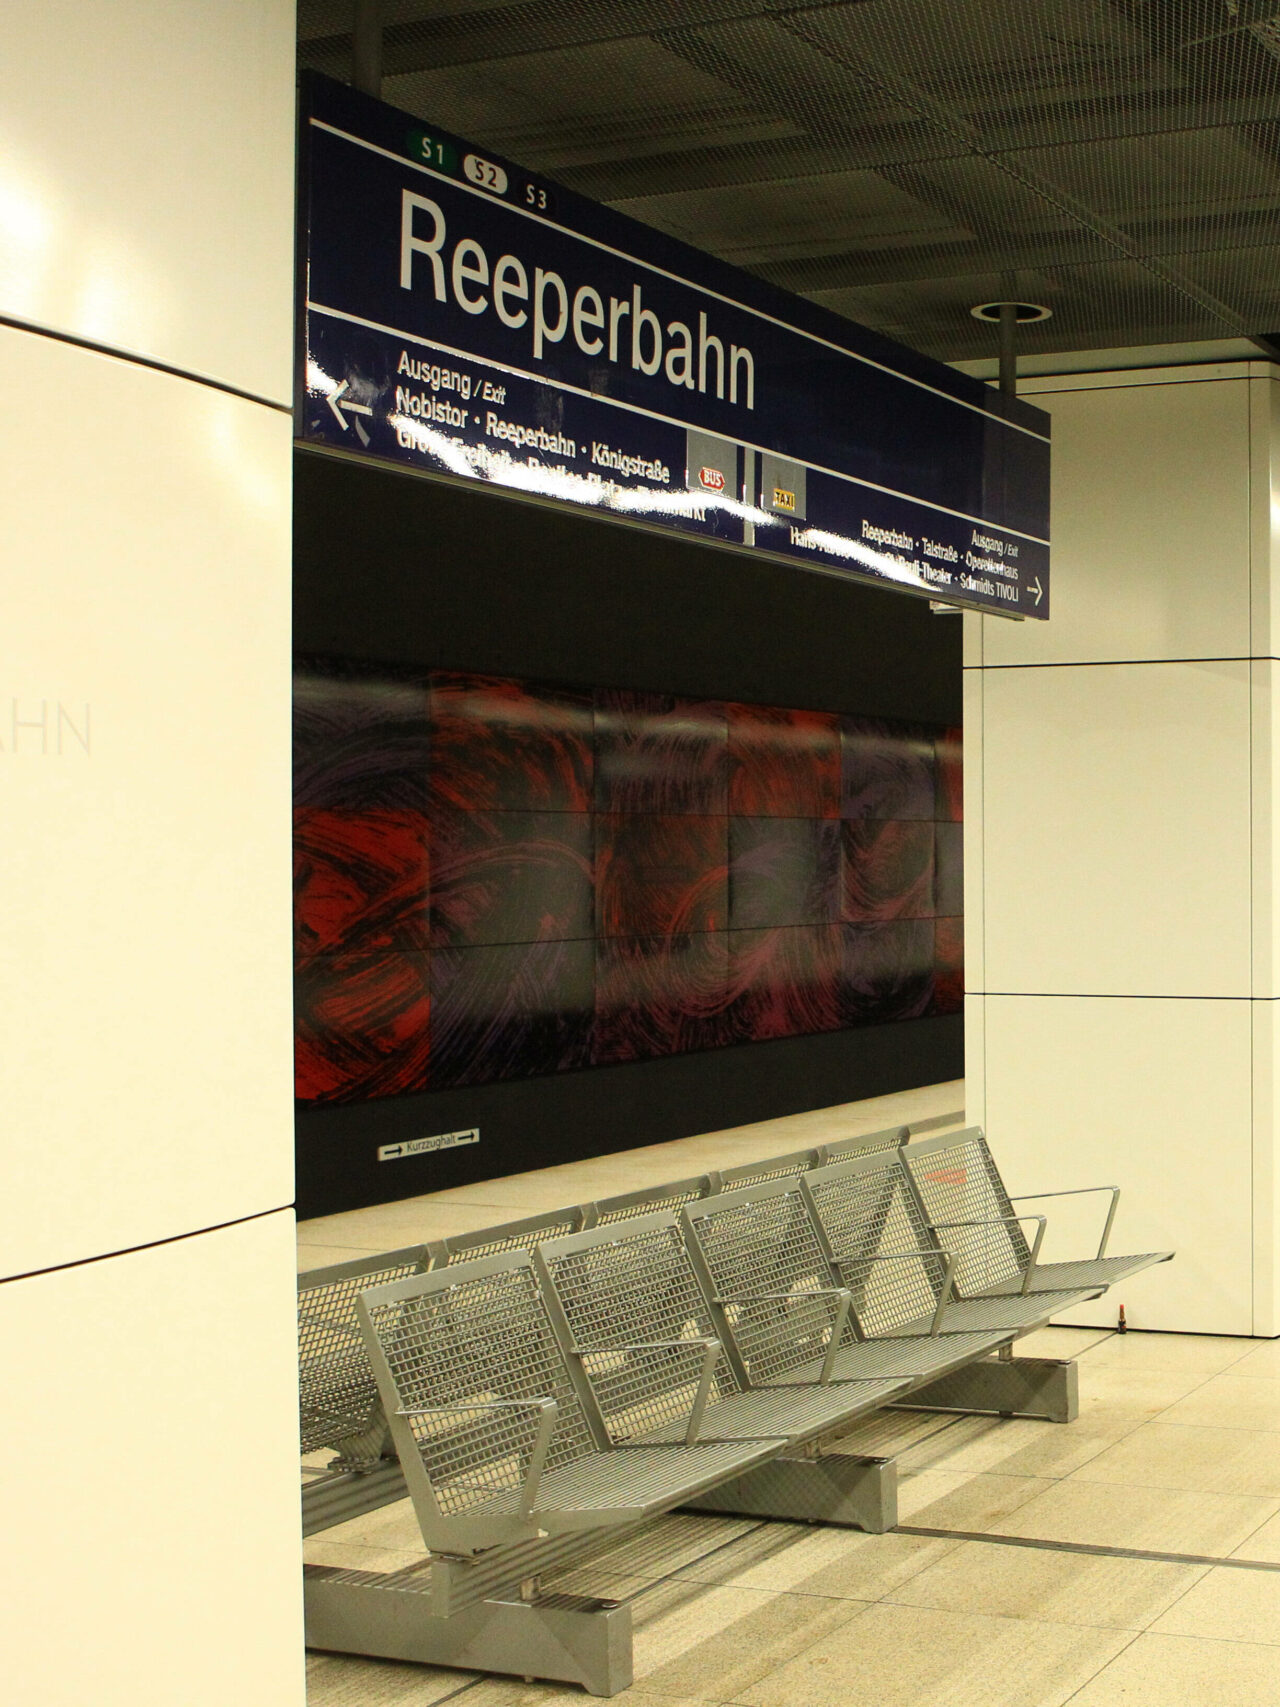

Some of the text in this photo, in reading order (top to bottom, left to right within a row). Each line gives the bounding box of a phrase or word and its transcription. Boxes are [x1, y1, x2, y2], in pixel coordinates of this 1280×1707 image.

[421, 136, 548, 210] S1 S2 S3
[399, 186, 755, 411] Reeperbahn
[396, 350, 471, 400] Ausgang
[482, 380, 506, 405] Exit
[395, 385, 469, 429] Nobistor
[485, 410, 577, 459] Reeperbahn
[591, 441, 671, 484] Königstraße
[702, 471, 723, 487] BUS
[775, 490, 795, 508] TAXI
[861, 519, 914, 551] Reeperbahn
[922, 536, 959, 564] Talstraße
[965, 550, 1019, 580] Operettenhaus
[970, 529, 1004, 557] Ausgang
[1007, 543, 1019, 558] Exit
[960, 572, 995, 597] Schmidts
[995, 581, 1019, 602] TIVOLI
[0, 696, 92, 757] HN
[406, 1133, 457, 1153] Kurzzughalt
